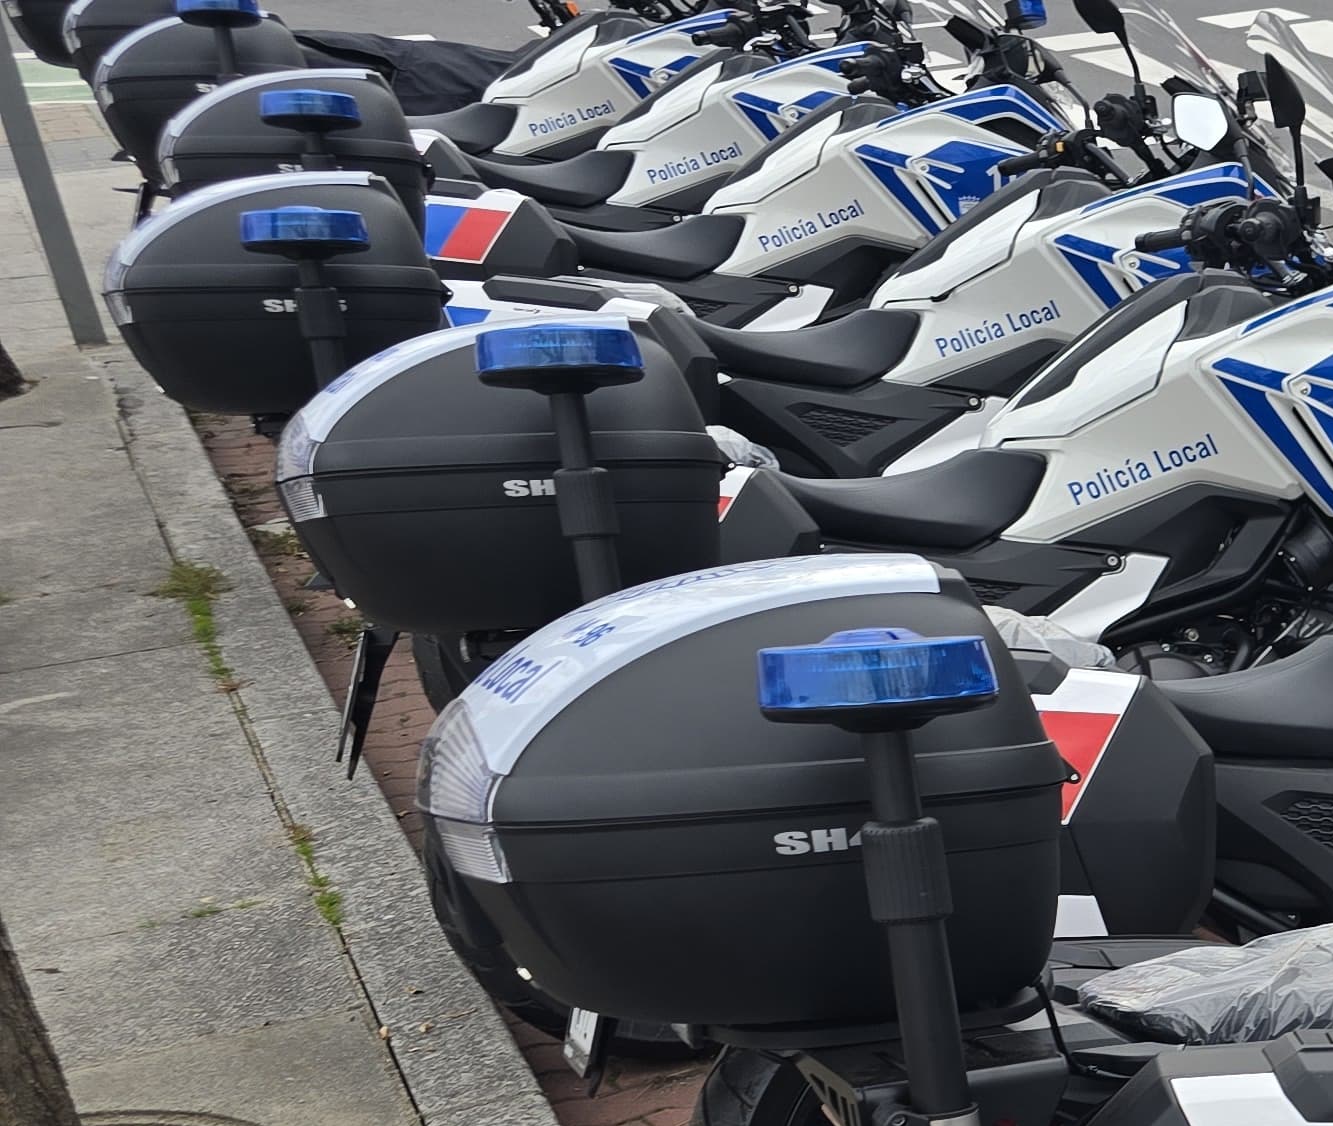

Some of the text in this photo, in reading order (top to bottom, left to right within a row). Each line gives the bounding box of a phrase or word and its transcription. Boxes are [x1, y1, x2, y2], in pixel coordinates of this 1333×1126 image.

[528, 100, 616, 137] Policía Local
[647, 142, 743, 184] Policía Local
[758, 199, 865, 252] Policía Local
[935, 300, 1062, 358] Policía Local
[1067, 433, 1219, 506] Policía Local
[481, 644, 563, 704] Local
